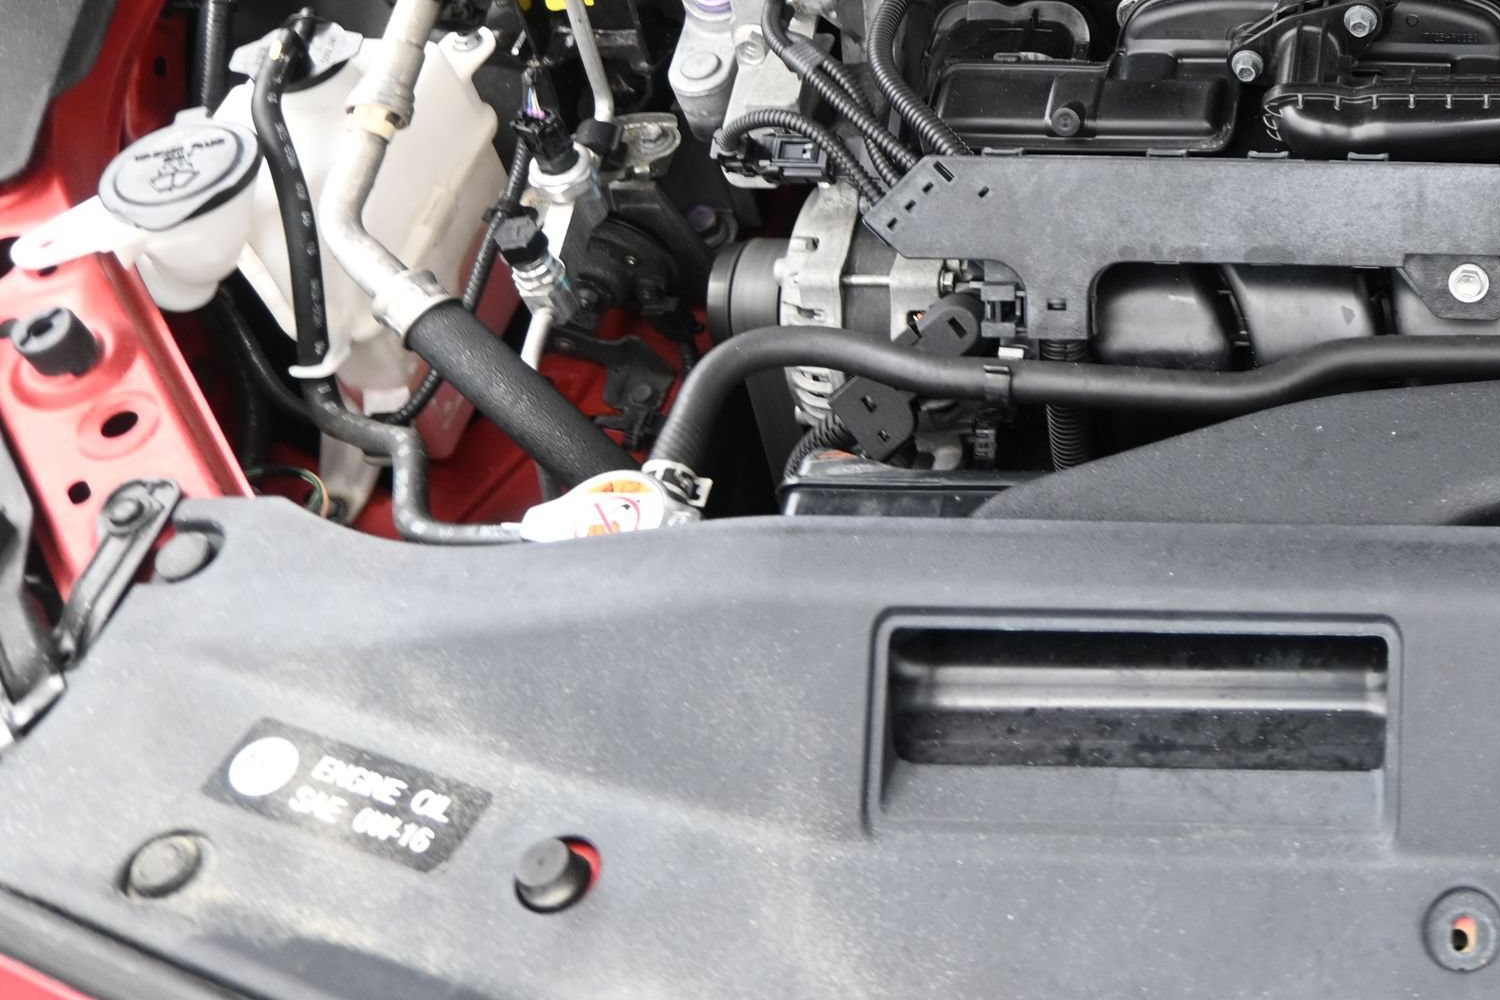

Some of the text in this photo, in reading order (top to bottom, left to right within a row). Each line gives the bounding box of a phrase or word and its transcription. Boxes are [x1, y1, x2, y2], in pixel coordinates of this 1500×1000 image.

[288, 785, 350, 824] SAE
[311, 755, 452, 823] ENGINE OIL
